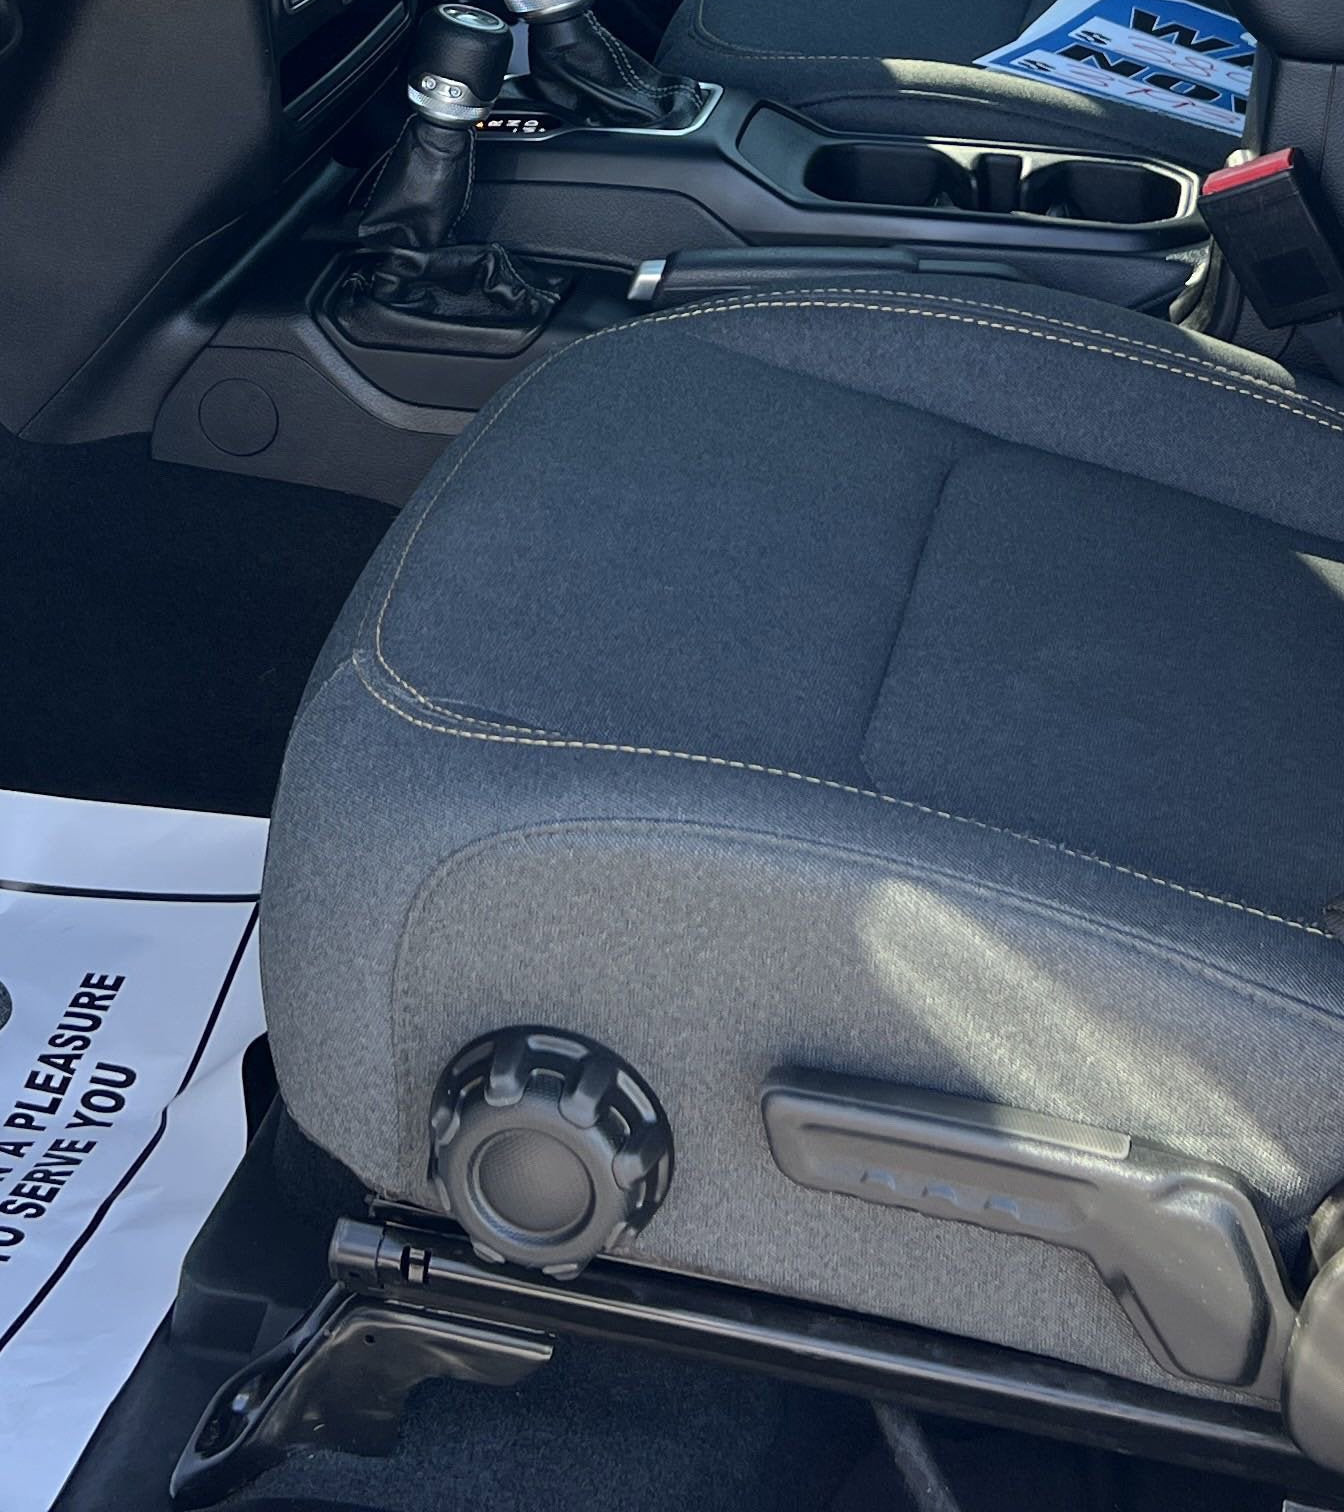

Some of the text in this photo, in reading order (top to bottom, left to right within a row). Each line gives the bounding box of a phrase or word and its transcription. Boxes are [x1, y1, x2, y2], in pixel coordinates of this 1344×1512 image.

[1056, 42, 1248, 115] NO
[3, 972, 126, 1131] PLEASURE
[65, 1061, 138, 1129] YOU
